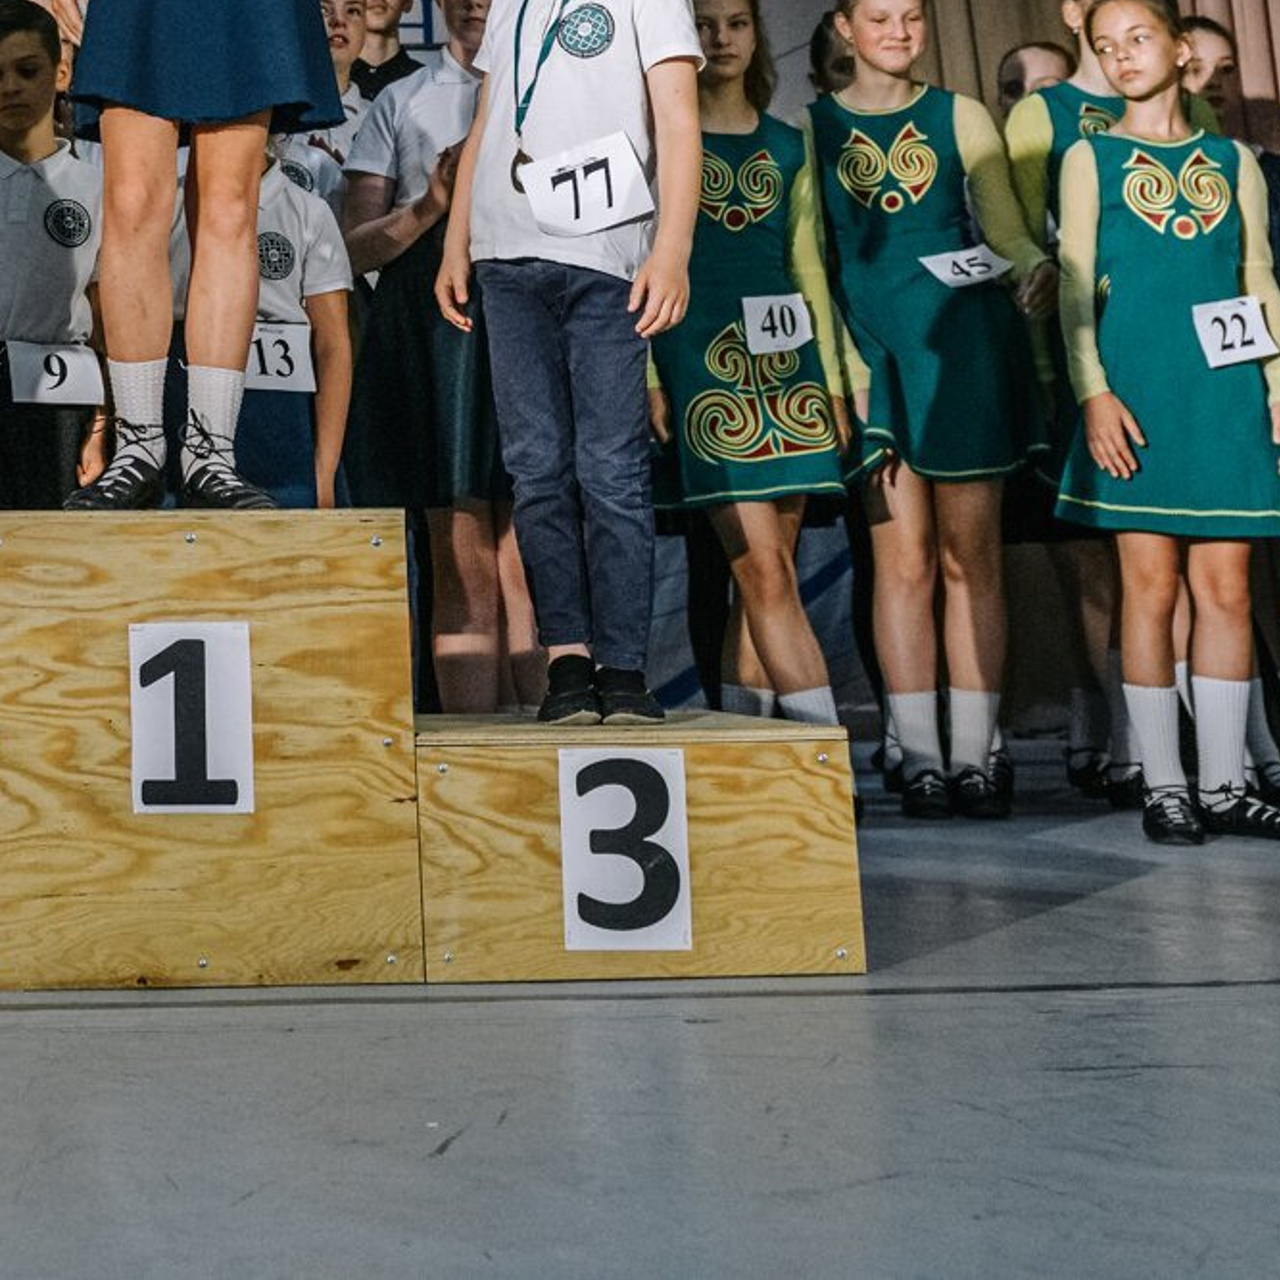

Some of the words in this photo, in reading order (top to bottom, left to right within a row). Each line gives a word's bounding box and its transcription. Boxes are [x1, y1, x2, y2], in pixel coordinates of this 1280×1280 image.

[551, 157, 613, 220] 77
[951, 256, 992, 277] 45
[761, 304, 796, 339] 40
[1211, 313, 1256, 351] 22
[43, 352, 68, 390] 9
[251, 337, 295, 378] 13
[140, 639, 238, 805] 1
[576, 758, 680, 931] 3
